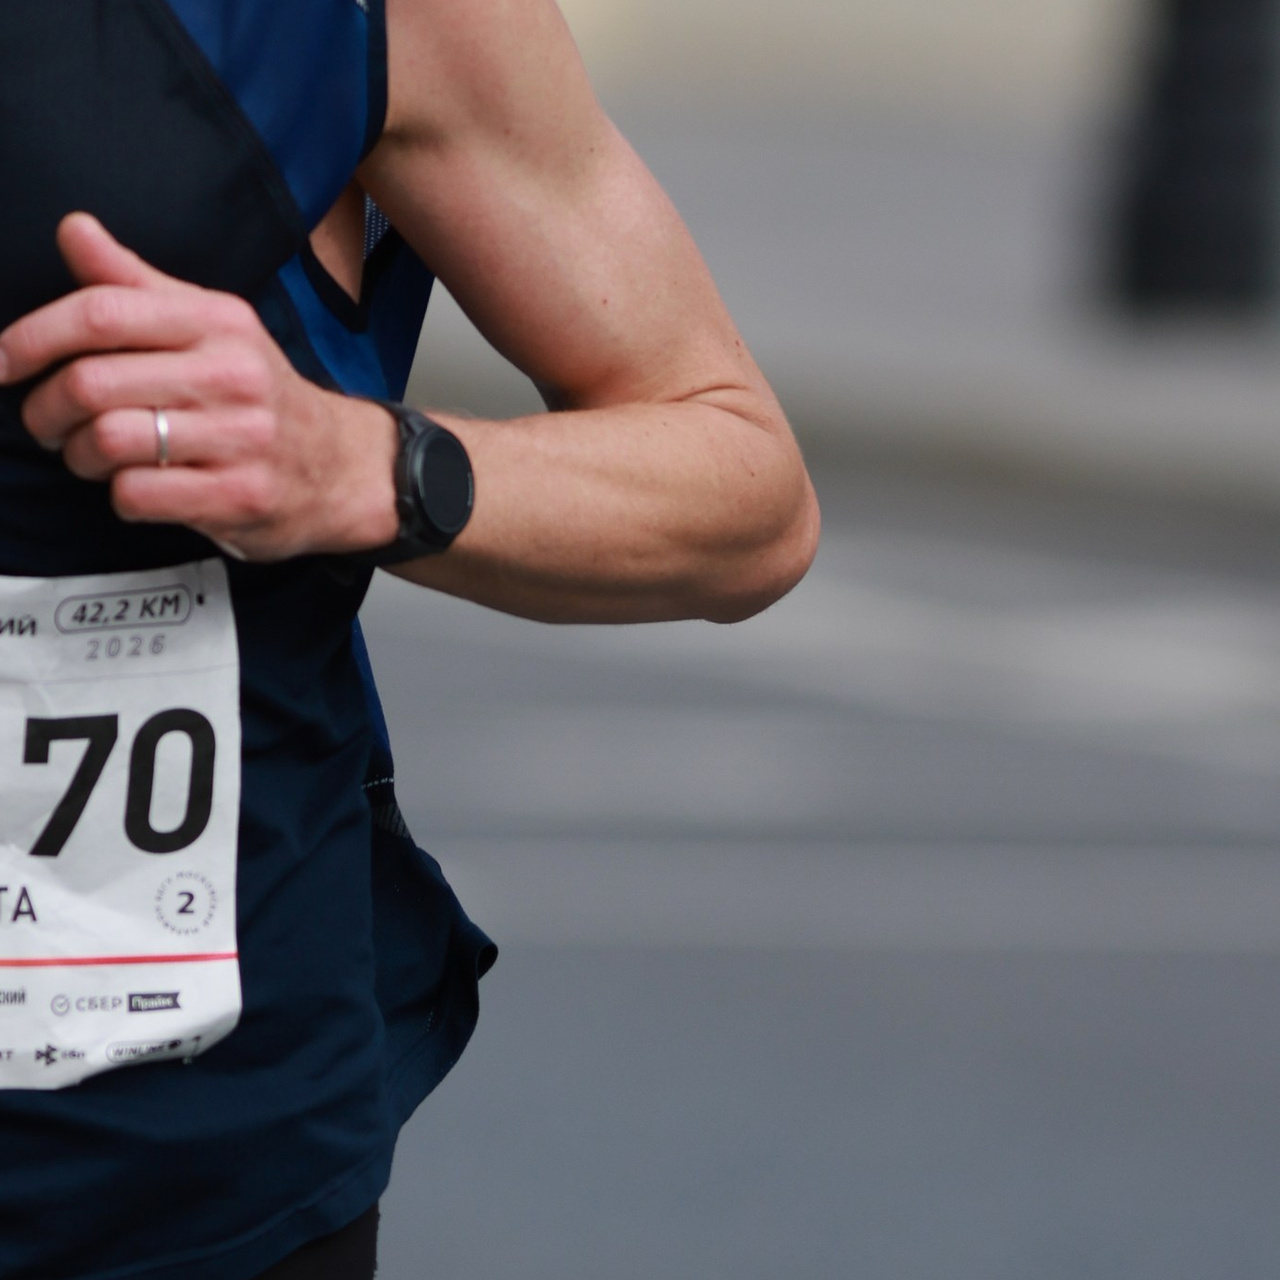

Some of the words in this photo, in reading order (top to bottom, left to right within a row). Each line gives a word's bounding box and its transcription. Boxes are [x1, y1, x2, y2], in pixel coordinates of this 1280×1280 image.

[71, 600, 129, 625] 42,2
[85, 634, 166, 661] 2026
[177, 891, 195, 914] 2
[75, 996, 122, 1011] СБЕР
